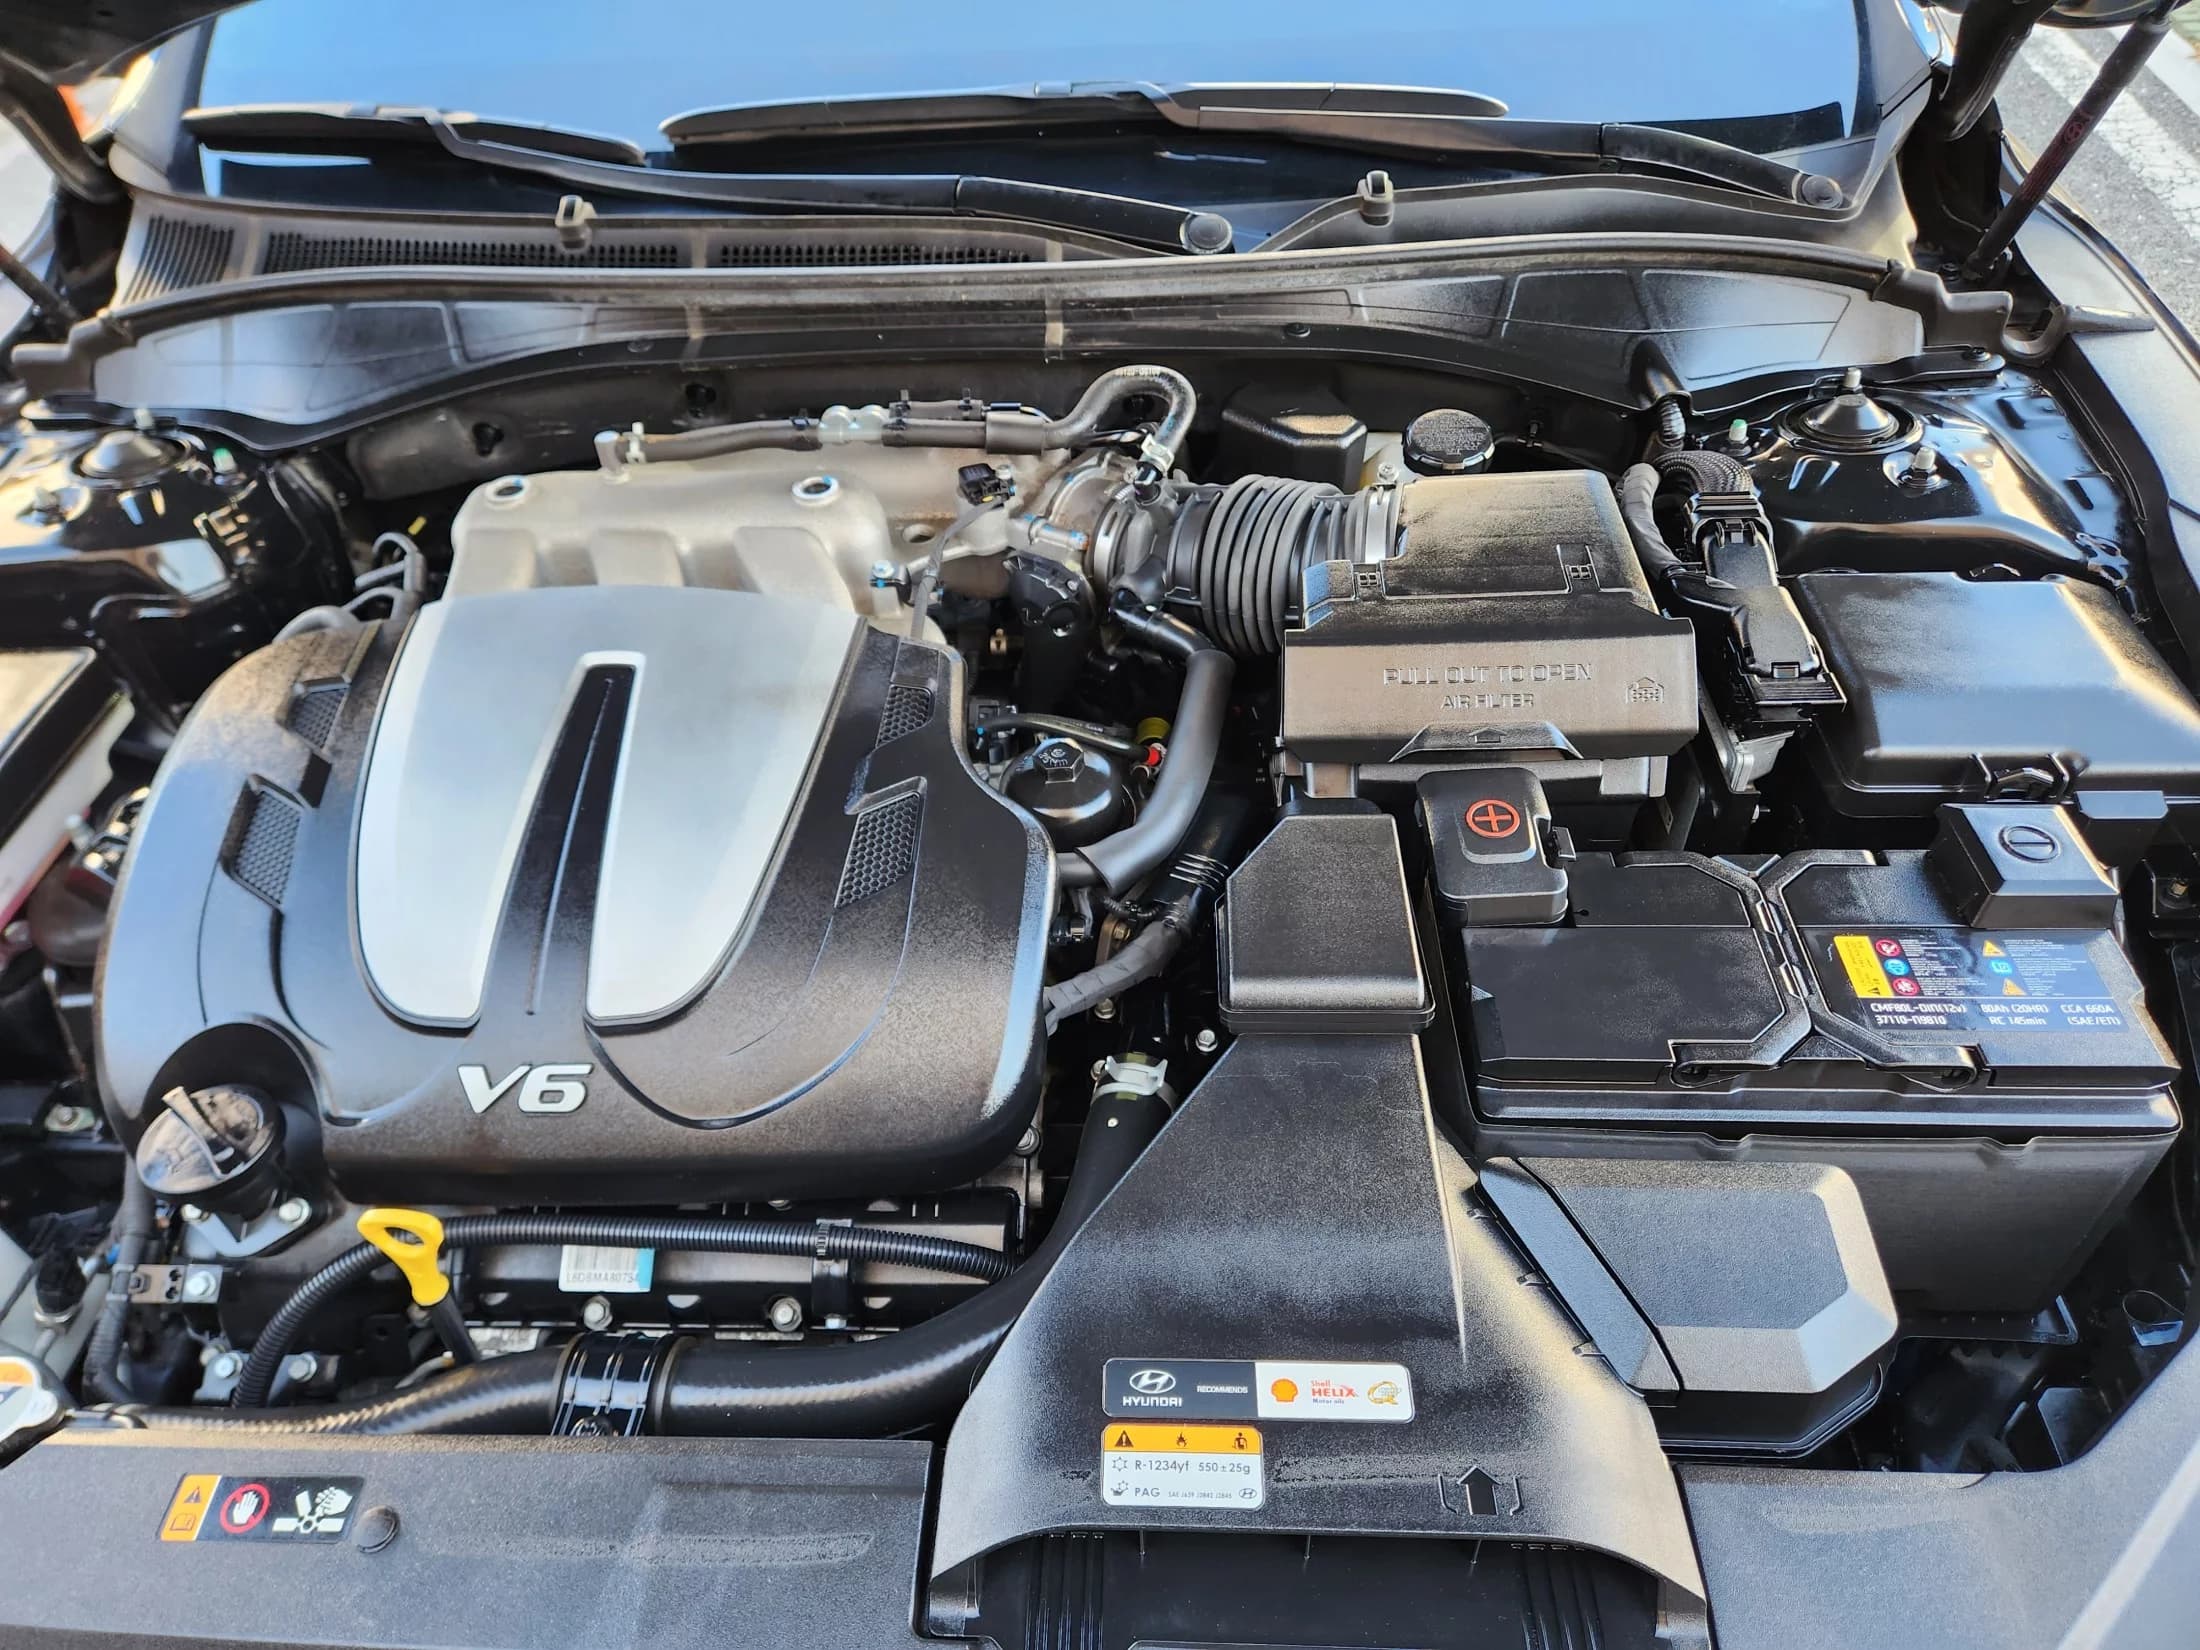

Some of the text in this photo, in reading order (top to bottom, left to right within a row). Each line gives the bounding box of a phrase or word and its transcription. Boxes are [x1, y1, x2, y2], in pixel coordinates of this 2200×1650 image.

[1383, 663, 1592, 685] PULL OUT TO OPEN
[1440, 692, 1534, 710] AIR FILTER
[1980, 1004, 2009, 1013] 80Ah
[2060, 1004, 2085, 1013] CCA
[2086, 1004, 2115, 1013] 660A
[1989, 1016, 2006, 1025] RC
[457, 1063, 594, 1114] V6
[1311, 1379, 1331, 1387] Shell
[1122, 1385, 1249, 1408] HYUNDAI RECOMMENDS
[1311, 1386, 1357, 1398] HELIX
[1134, 1460, 1190, 1474] R-1234yf
[1134, 1487, 1161, 1498] PAG
[1168, 1490, 1180, 1498] SAE
